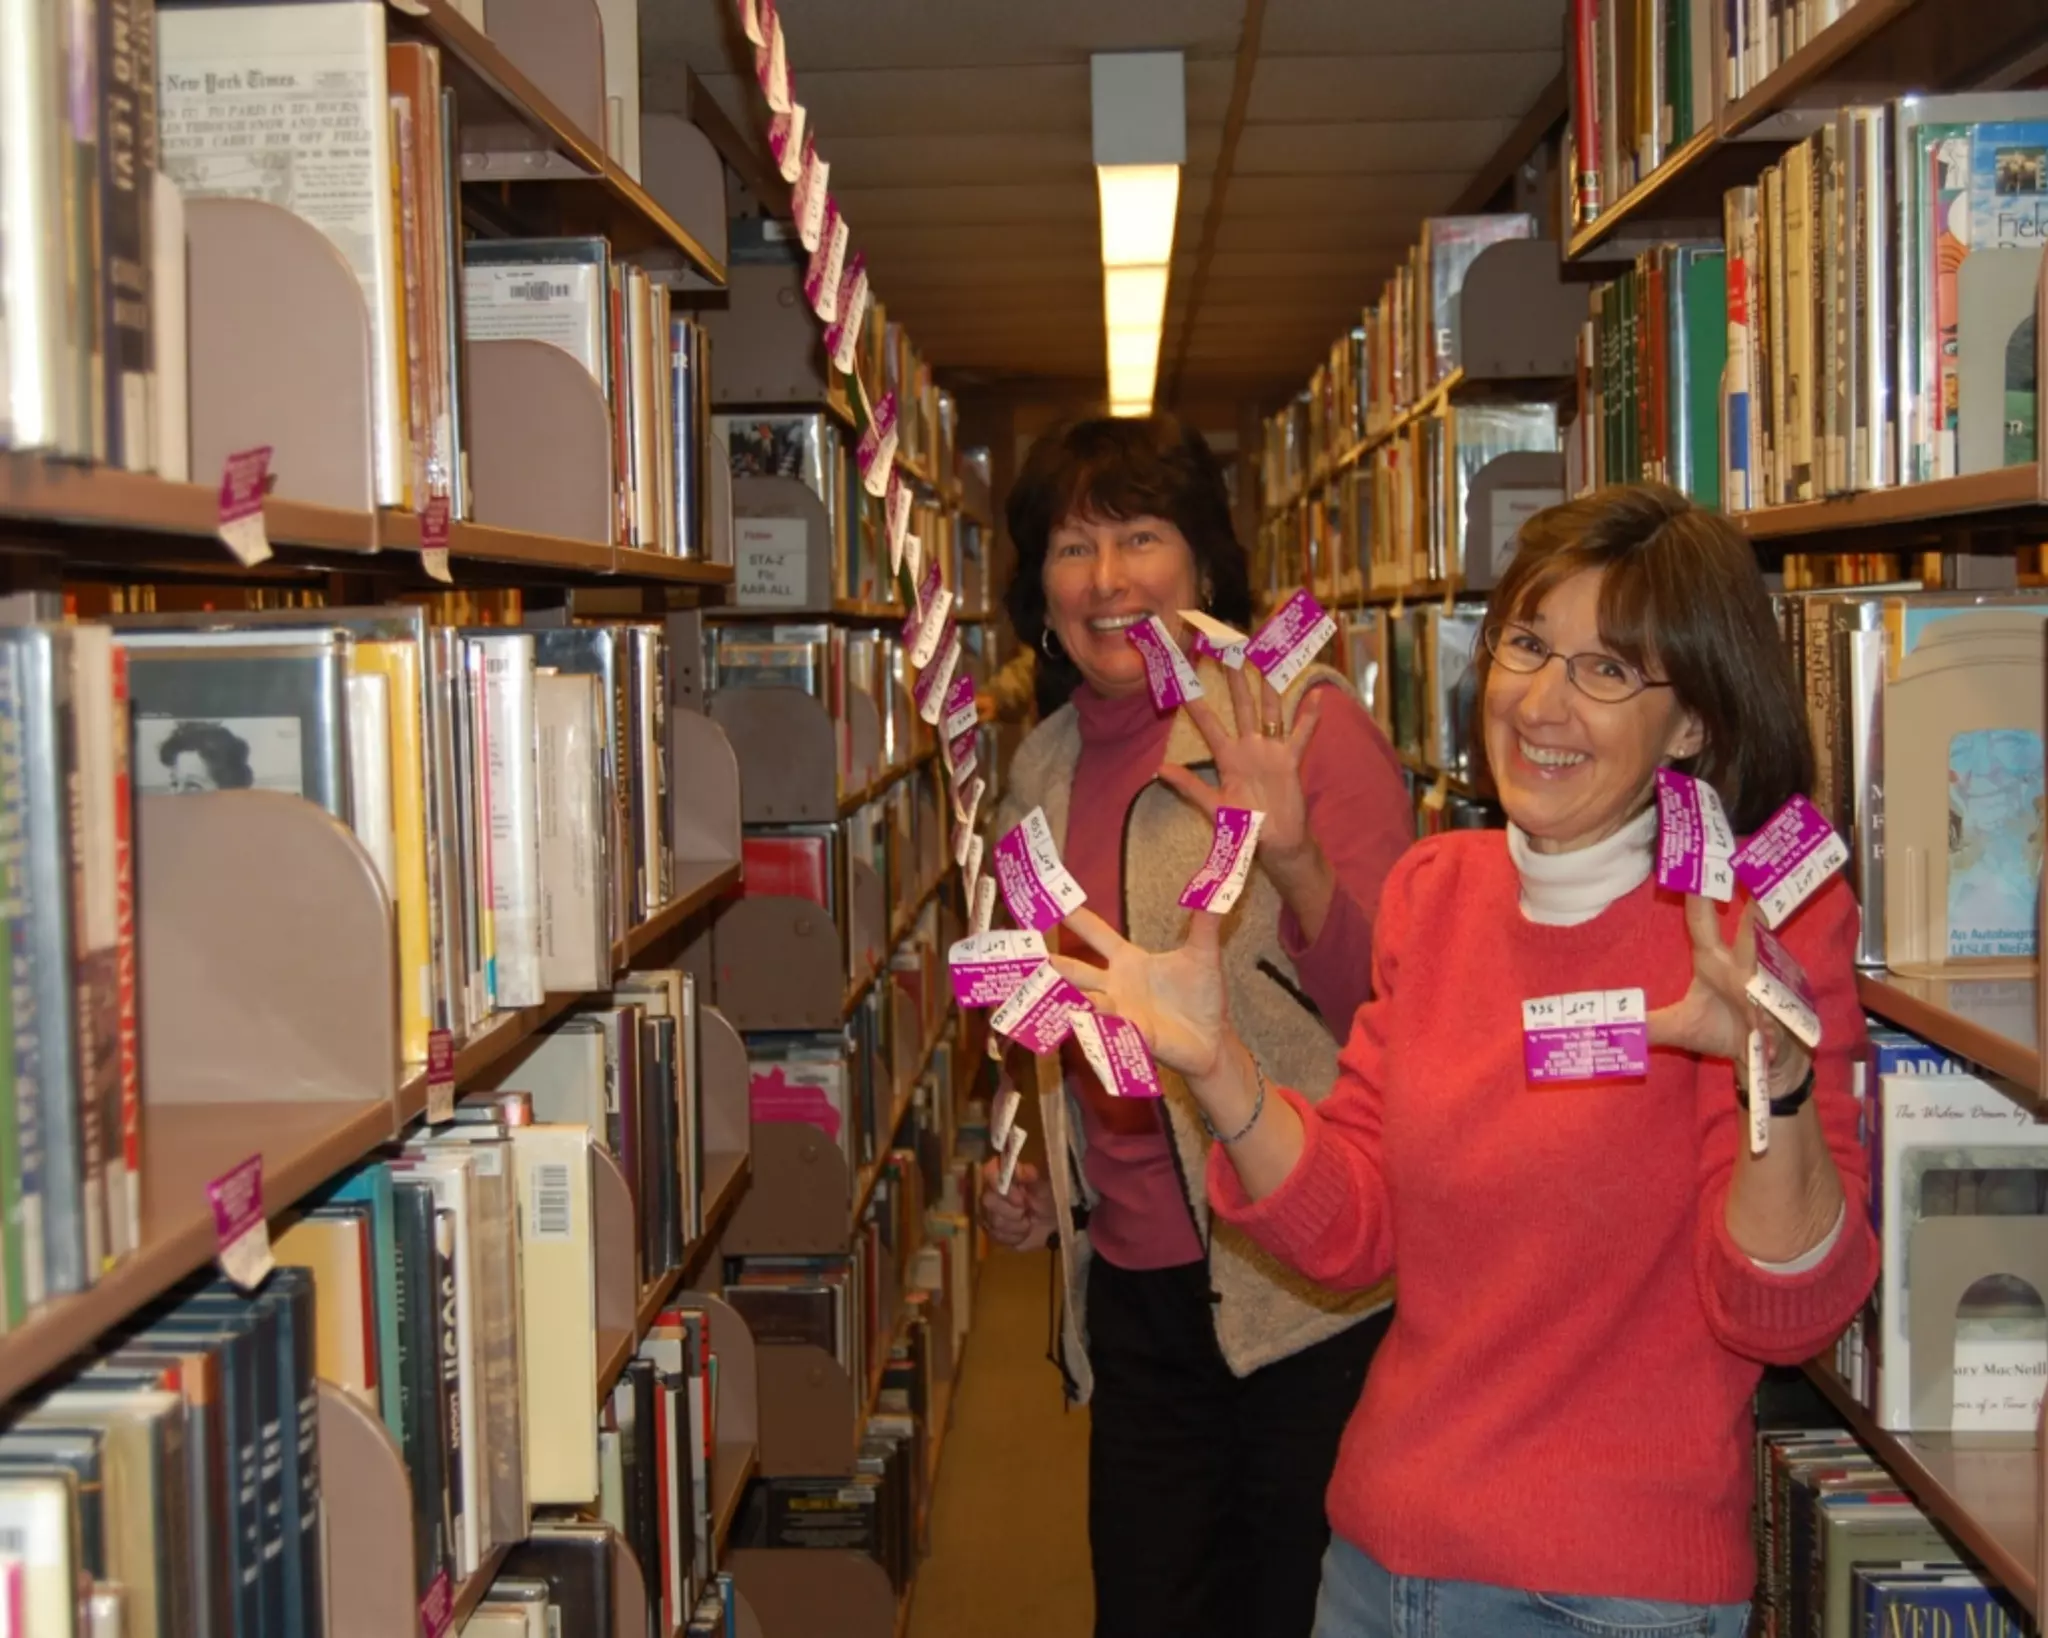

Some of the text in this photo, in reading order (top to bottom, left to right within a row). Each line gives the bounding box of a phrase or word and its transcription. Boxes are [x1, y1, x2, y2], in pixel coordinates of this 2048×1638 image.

[167, 74, 200, 92] New
[205, 73, 242, 94] York
[1714, 870, 1727, 884] 2
[1617, 997, 1628, 1012] 2
[1896, 1104, 1916, 1119] The
[2013, 1104, 2029, 1127] by
